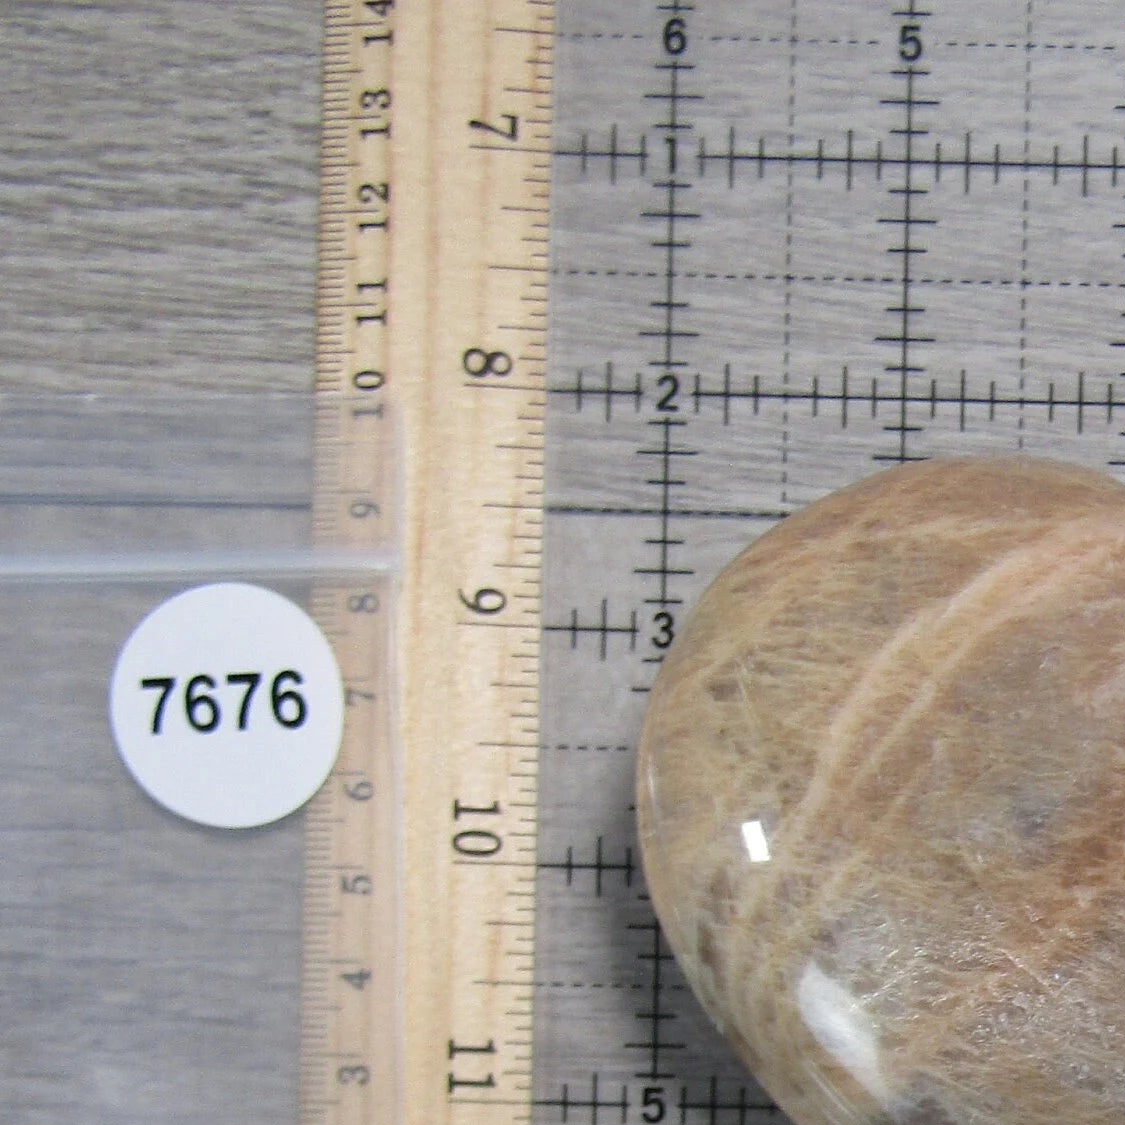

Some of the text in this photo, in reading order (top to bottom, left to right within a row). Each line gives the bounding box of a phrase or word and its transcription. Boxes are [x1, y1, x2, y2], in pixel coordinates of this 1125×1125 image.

[662, 18, 687, 55] 6
[900, 25, 923, 62] 5
[360, 88, 393, 140] 13
[468, 113, 520, 142] 7
[664, 138, 678, 174] 1
[358, 182, 391, 233] 12
[355, 277, 388, 326] 11
[463, 347, 513, 379] 8
[353, 369, 386, 421] 10
[656, 374, 680, 412] 2
[458, 588, 507, 615] 9
[652, 611, 675, 649] 3
[140, 669, 309, 735] 7676
[452, 799, 502, 857] 10
[341, 874, 373, 896] 5
[340, 967, 372, 991] 4
[336, 1064, 371, 1086] 3
[448, 1038, 498, 1094] 11
[641, 1087, 667, 1124] 5
